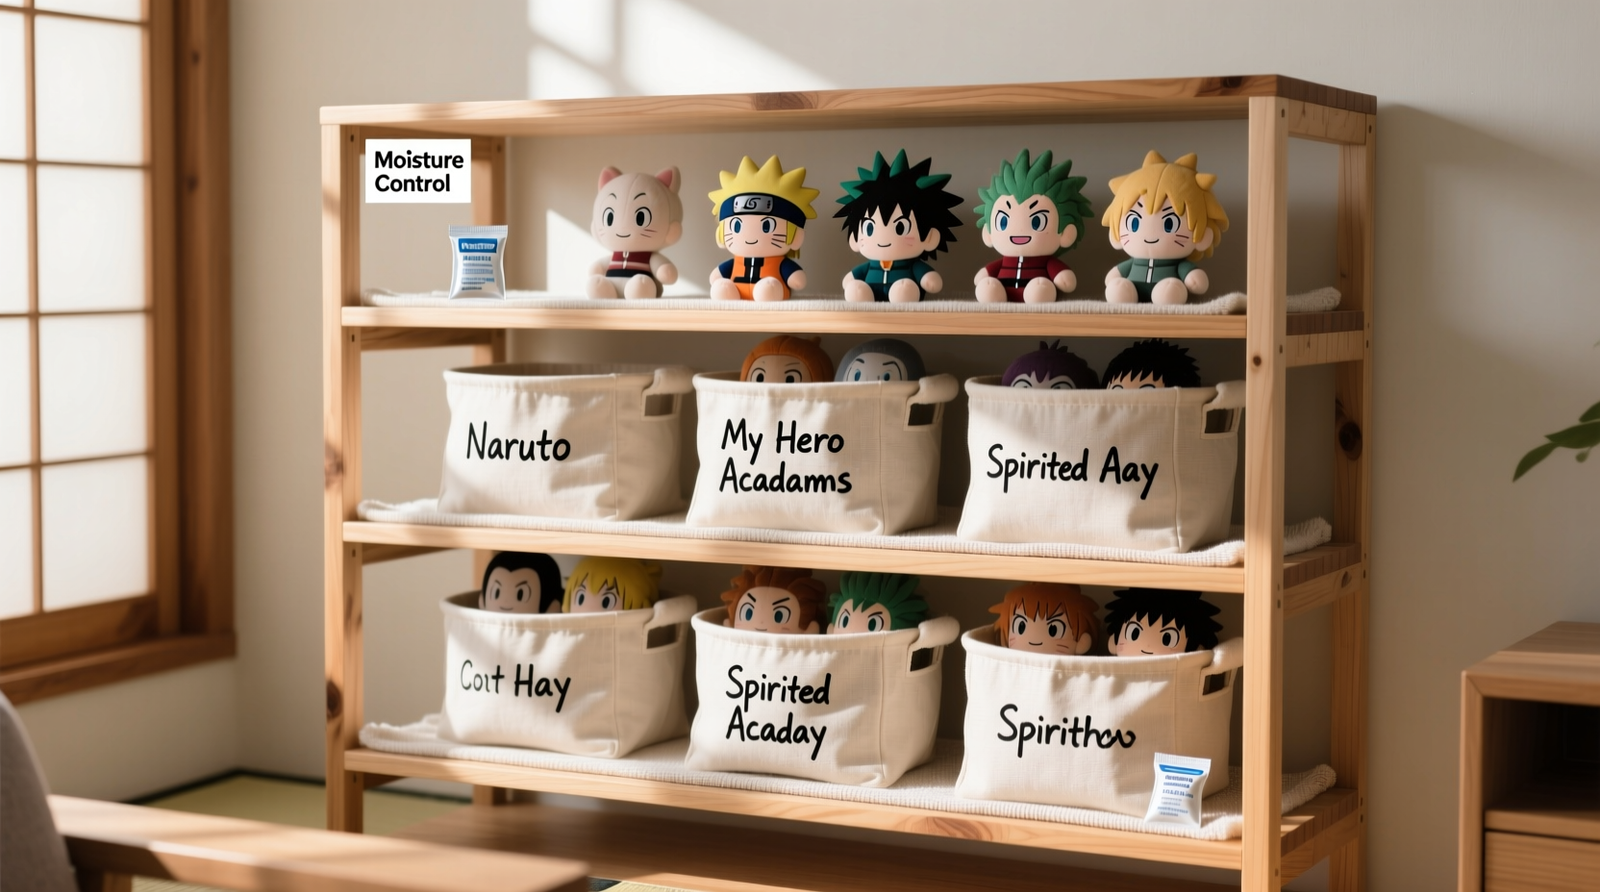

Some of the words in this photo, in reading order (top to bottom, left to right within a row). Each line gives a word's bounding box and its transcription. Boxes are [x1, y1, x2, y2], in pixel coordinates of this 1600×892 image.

[374, 150, 464, 169] Moisture
[374, 174, 450, 192] Control
[466, 421, 571, 461] Naruto
[721, 418, 763, 465] My
[776, 420, 844, 454] Hero
[987, 443, 1090, 493] Spirited
[1099, 446, 1159, 500] Aay
[514, 663, 571, 713] Hay
[726, 664, 832, 713] Spirited
[726, 705, 827, 761] Acaday
